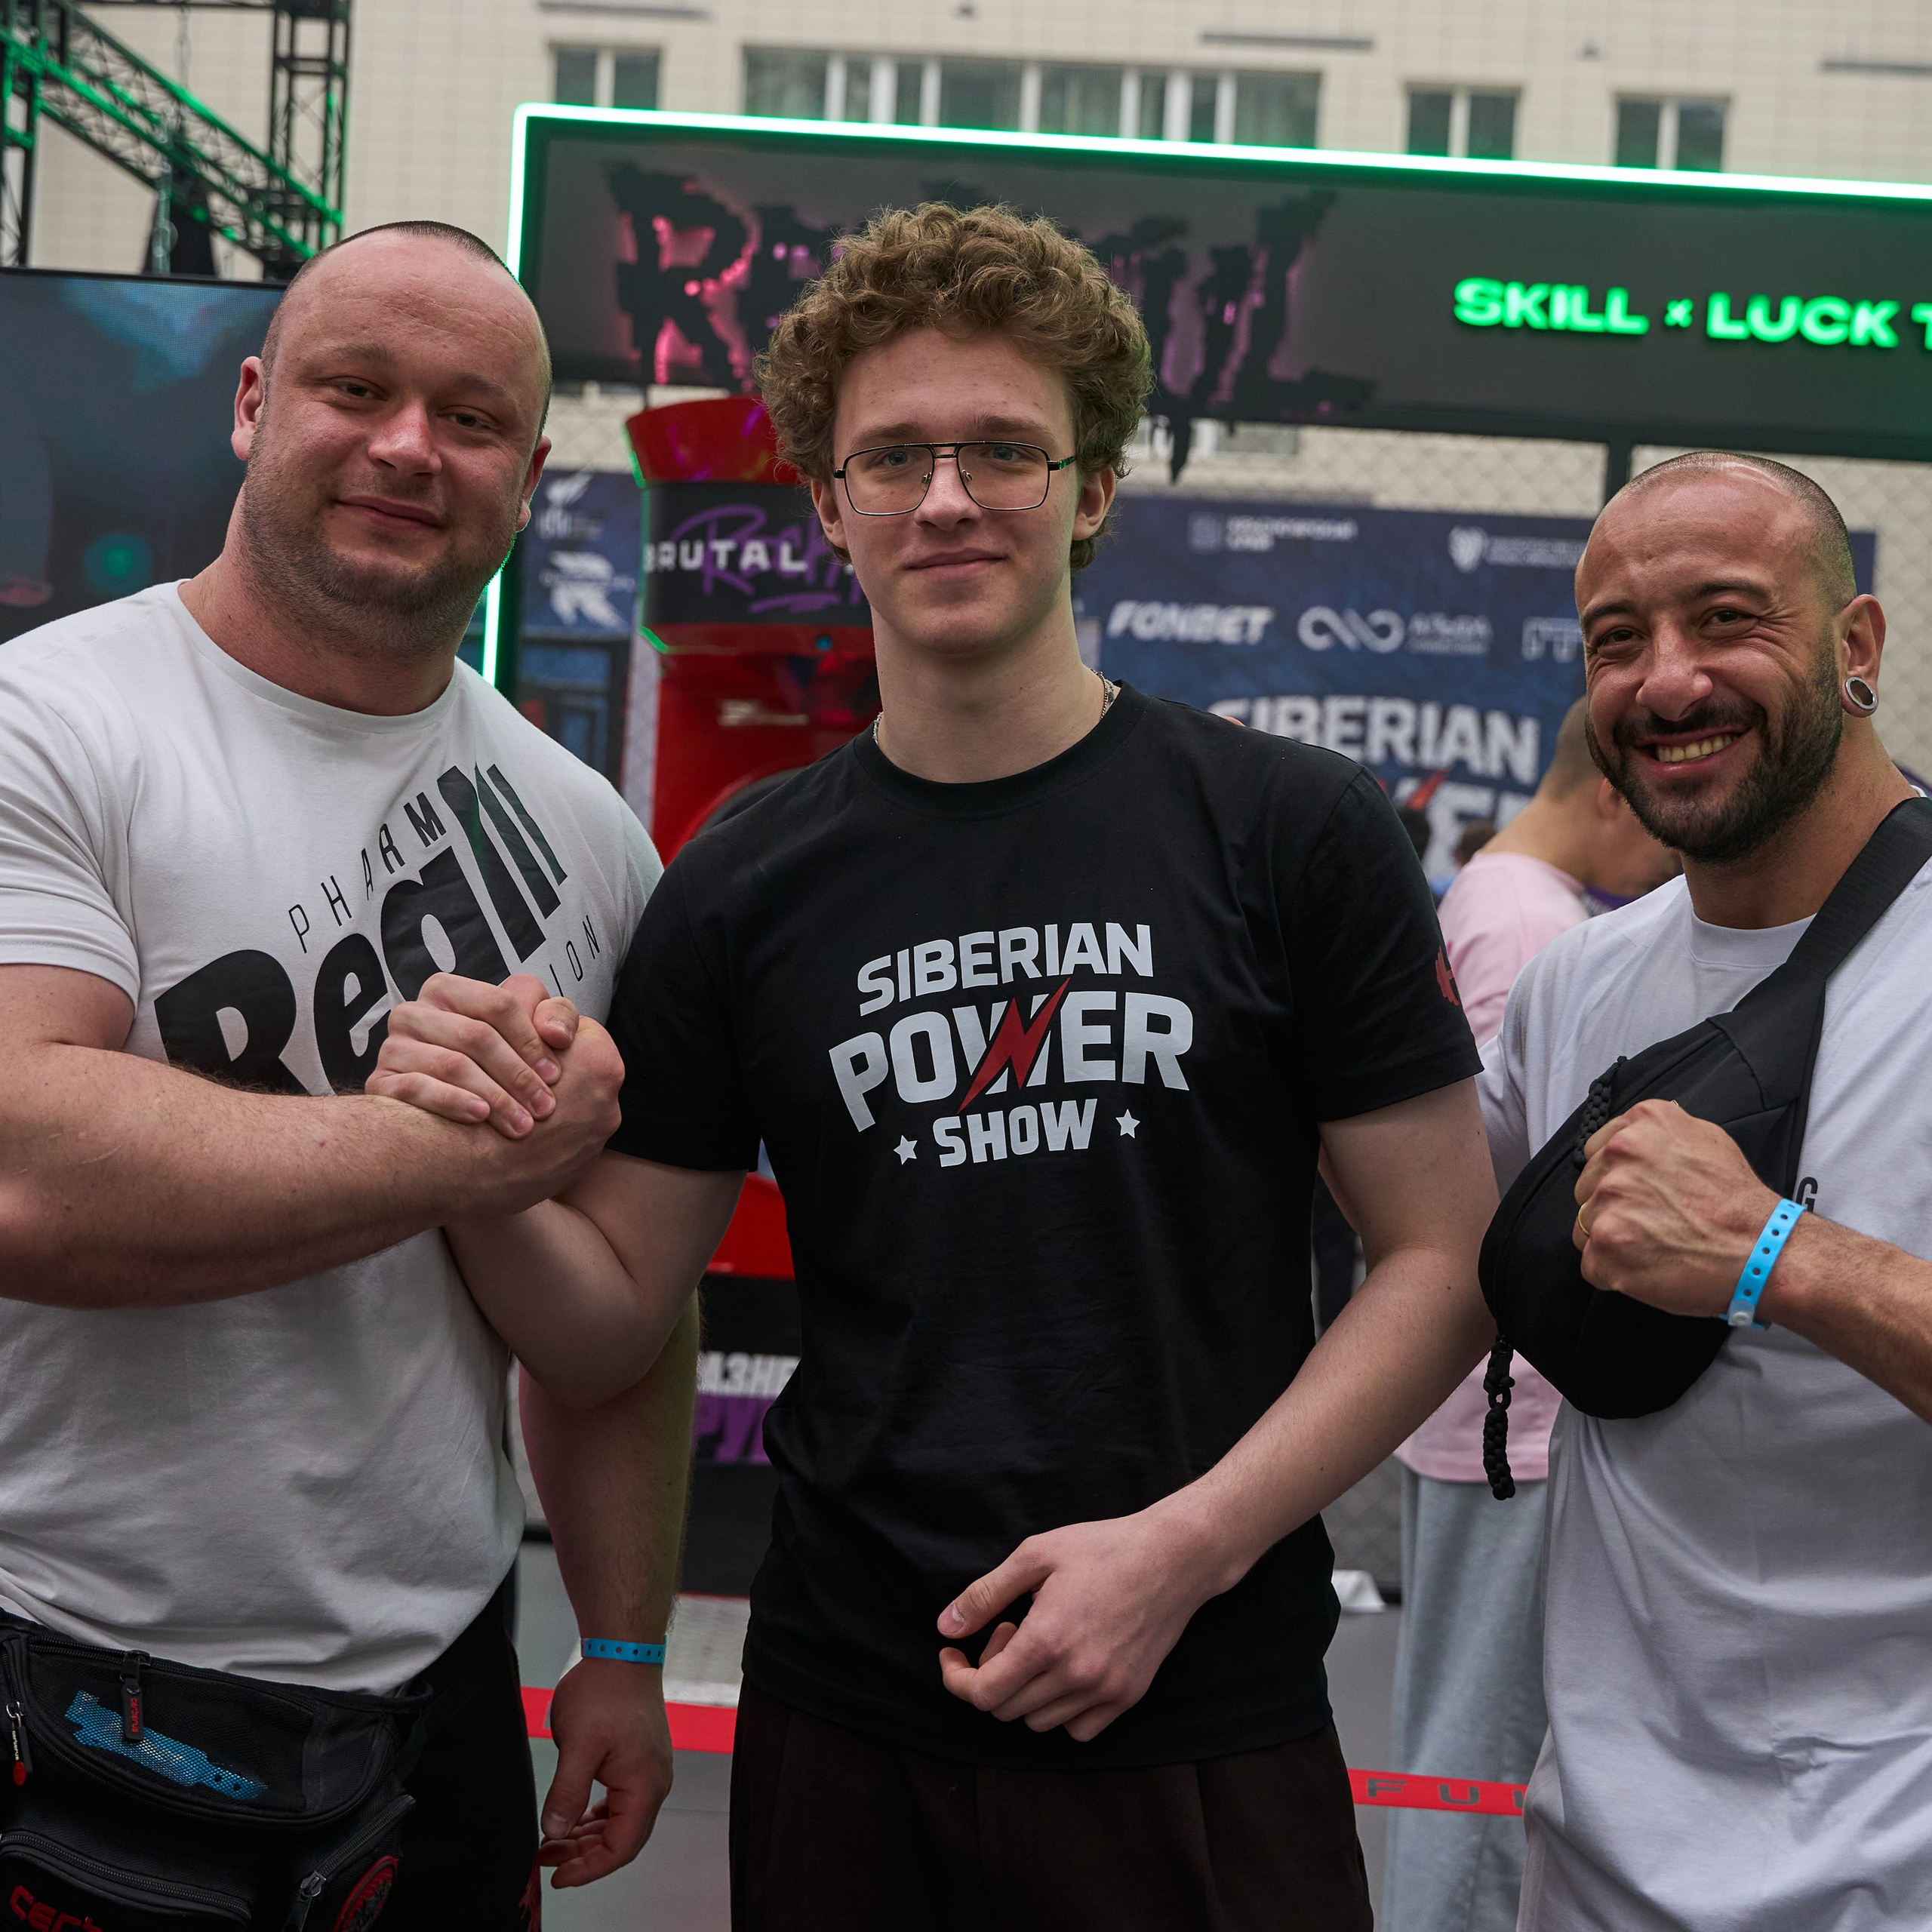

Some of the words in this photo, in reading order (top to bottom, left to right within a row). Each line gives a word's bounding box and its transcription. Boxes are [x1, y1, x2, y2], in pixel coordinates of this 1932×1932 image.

[1454, 277, 1650, 335] SKILL
[1706, 292, 1900, 348] LUCK
[288, 792, 447, 954] PHARM
[857, 922, 1153, 1017] SIBERIAN
[829, 990, 1193, 1132] POWER
[932, 1098, 1097, 1168] SHOW
